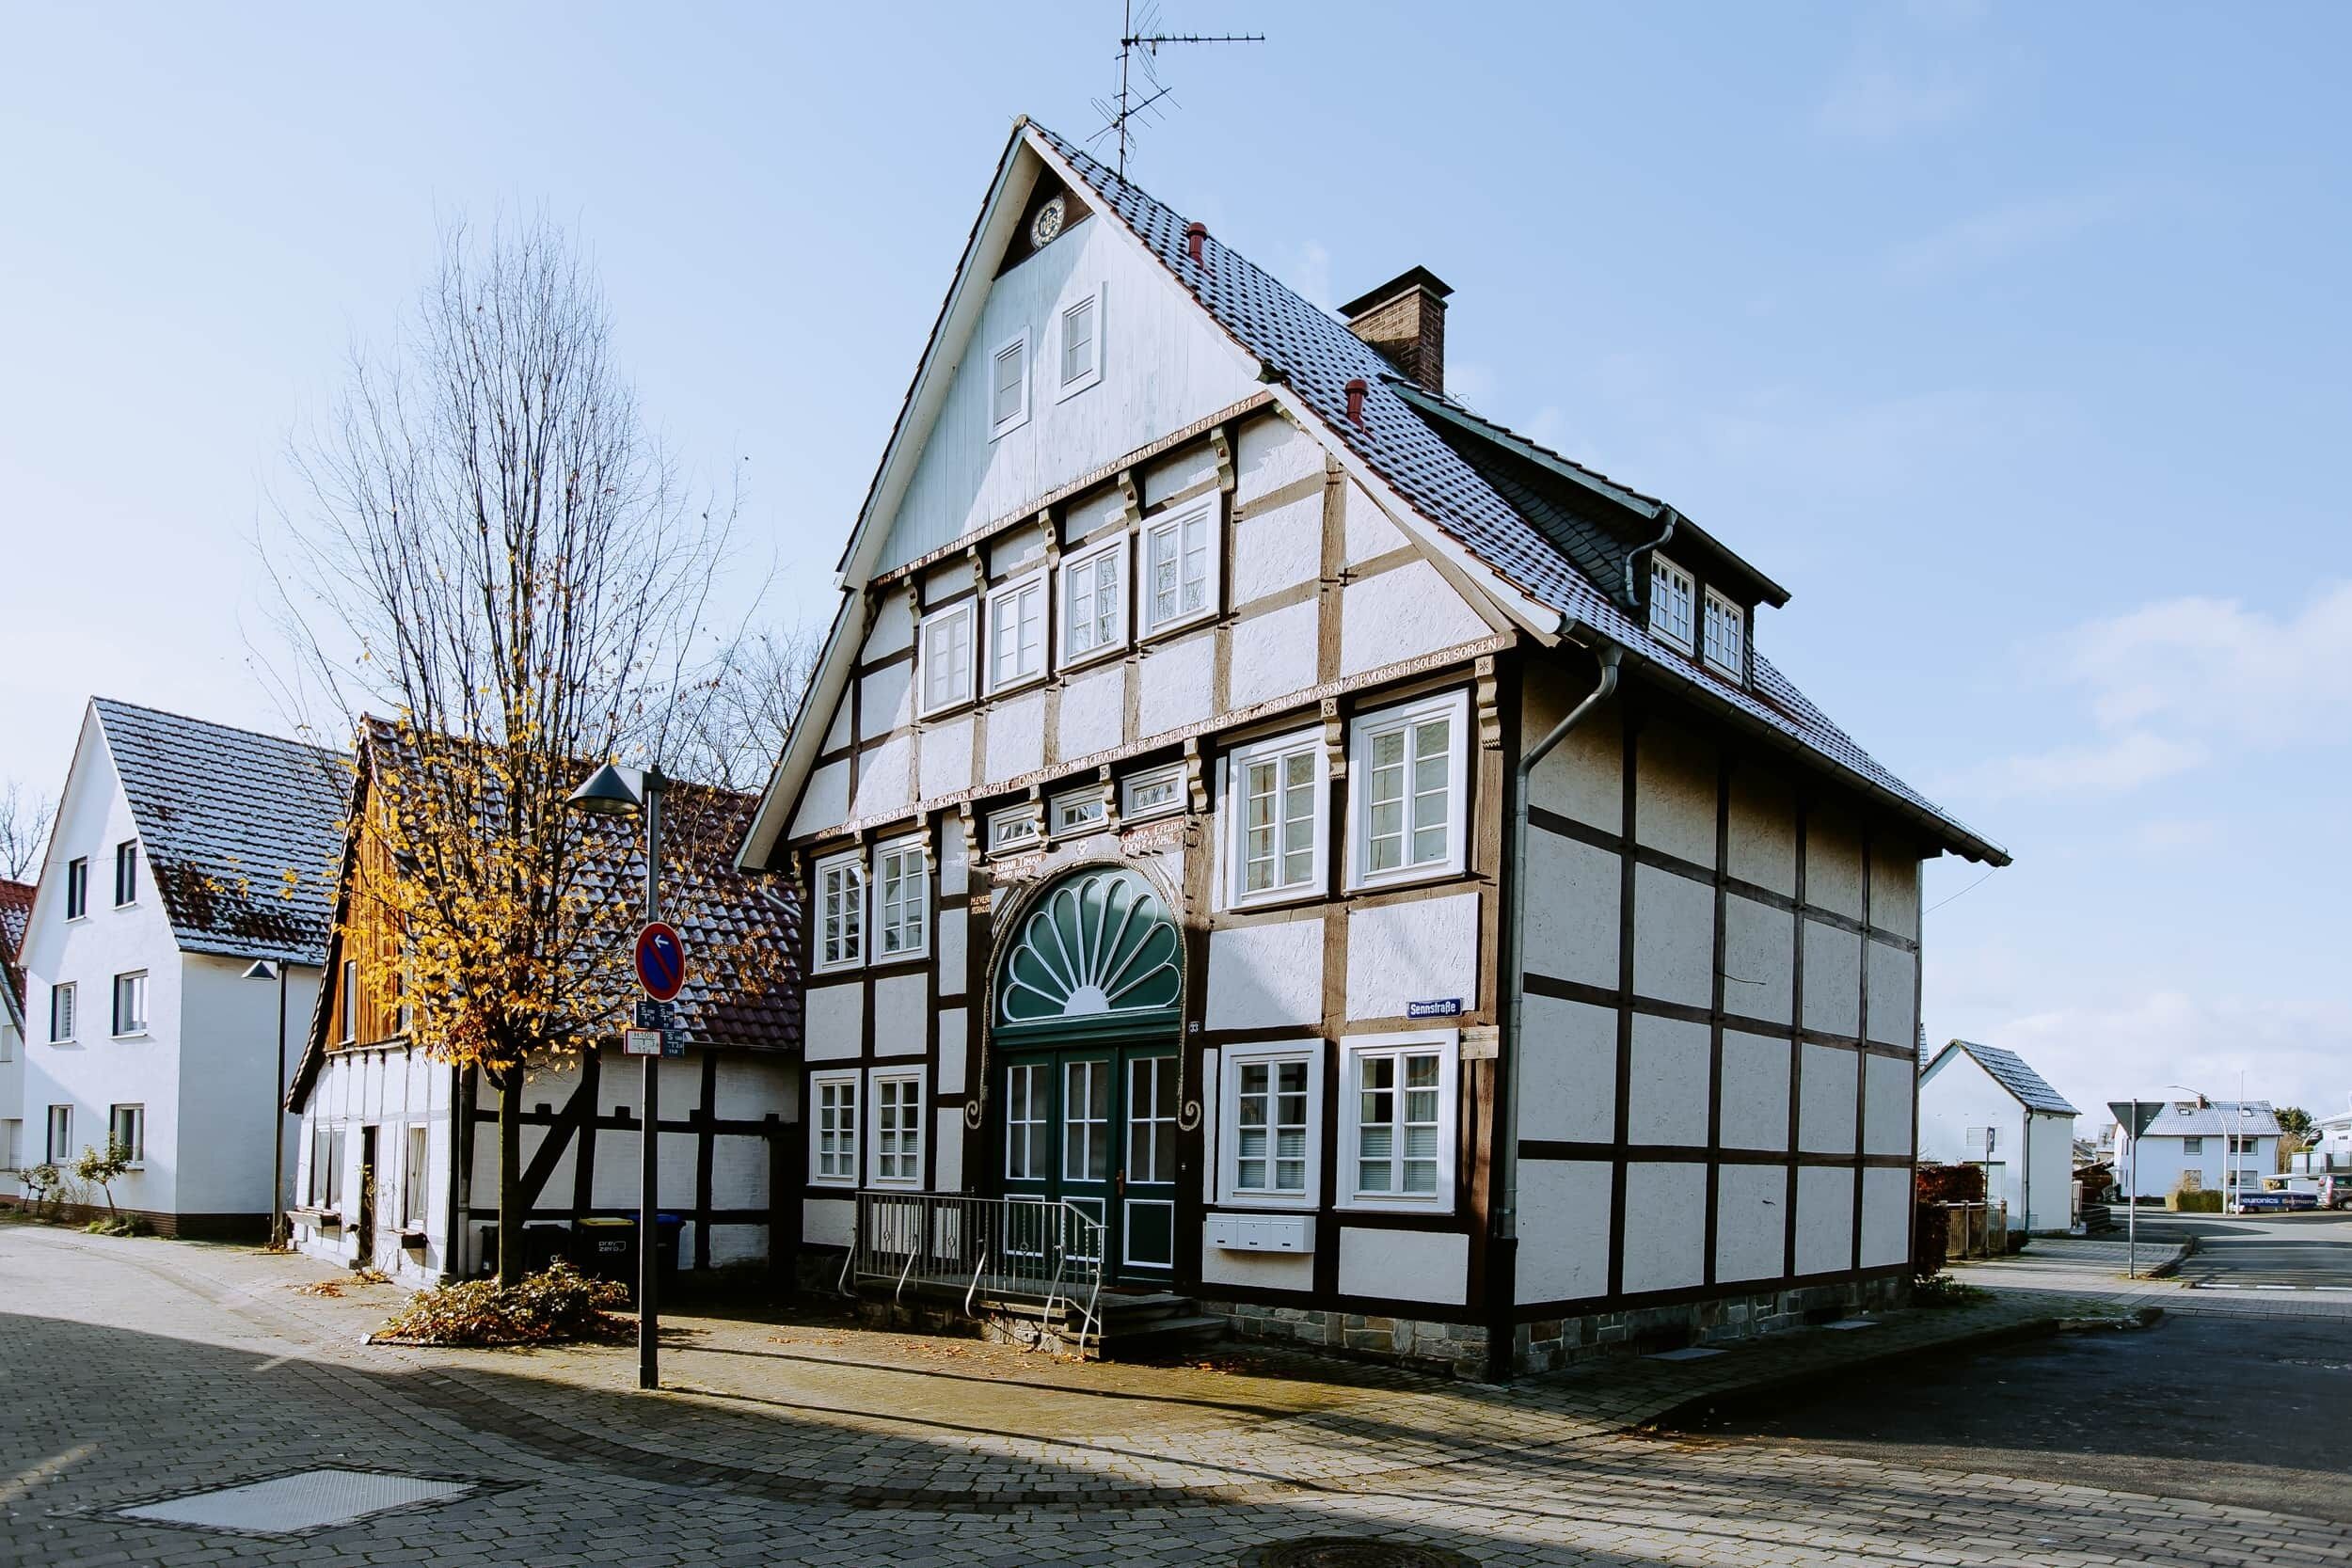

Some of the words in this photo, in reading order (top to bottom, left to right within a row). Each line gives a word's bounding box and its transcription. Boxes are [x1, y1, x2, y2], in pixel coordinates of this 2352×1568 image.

[909, 557, 923, 572] WEG
[1230, 397, 1253, 417] 1951
[1388, 658, 1411, 678] SICH
[1454, 637, 1498, 659] SORGEN
[1410, 1000, 1457, 1016] Sennstraße
